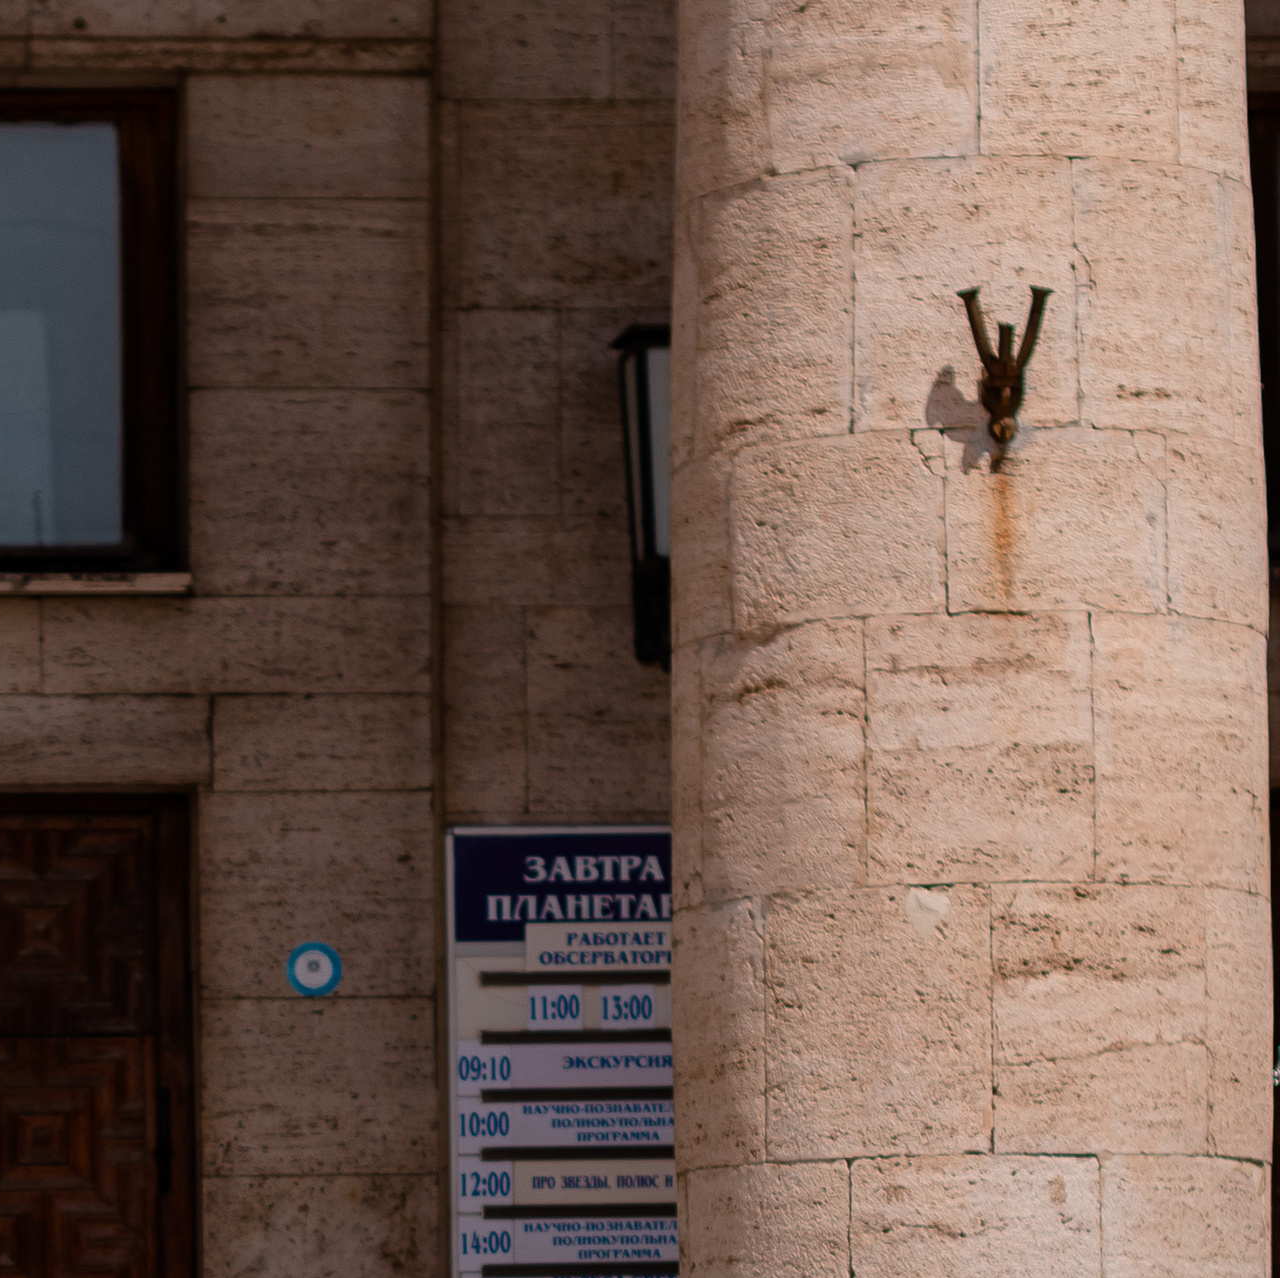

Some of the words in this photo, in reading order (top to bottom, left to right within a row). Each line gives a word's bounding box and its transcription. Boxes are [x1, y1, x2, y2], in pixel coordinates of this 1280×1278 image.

[523, 855, 664, 882] ЗАВТРА
[566, 932, 666, 946] РАБОТАЕТ
[529, 994, 580, 1020] 11:00
[602, 994, 652, 1020] 13:00
[458, 1056, 511, 1081] 09:10
[562, 1055, 673, 1070] ЭКСКУРСИЯ
[459, 1111, 509, 1137] 10:00
[577, 1131, 660, 1142] ПРОГРАММА
[460, 1171, 511, 1197] 12:00
[532, 1175, 556, 1189] ПРО
[616, 1174, 659, 1188] ПОЛЮС
[461, 1230, 511, 1255] 14:00
[578, 1248, 661, 1260] ПРОГРАММА
